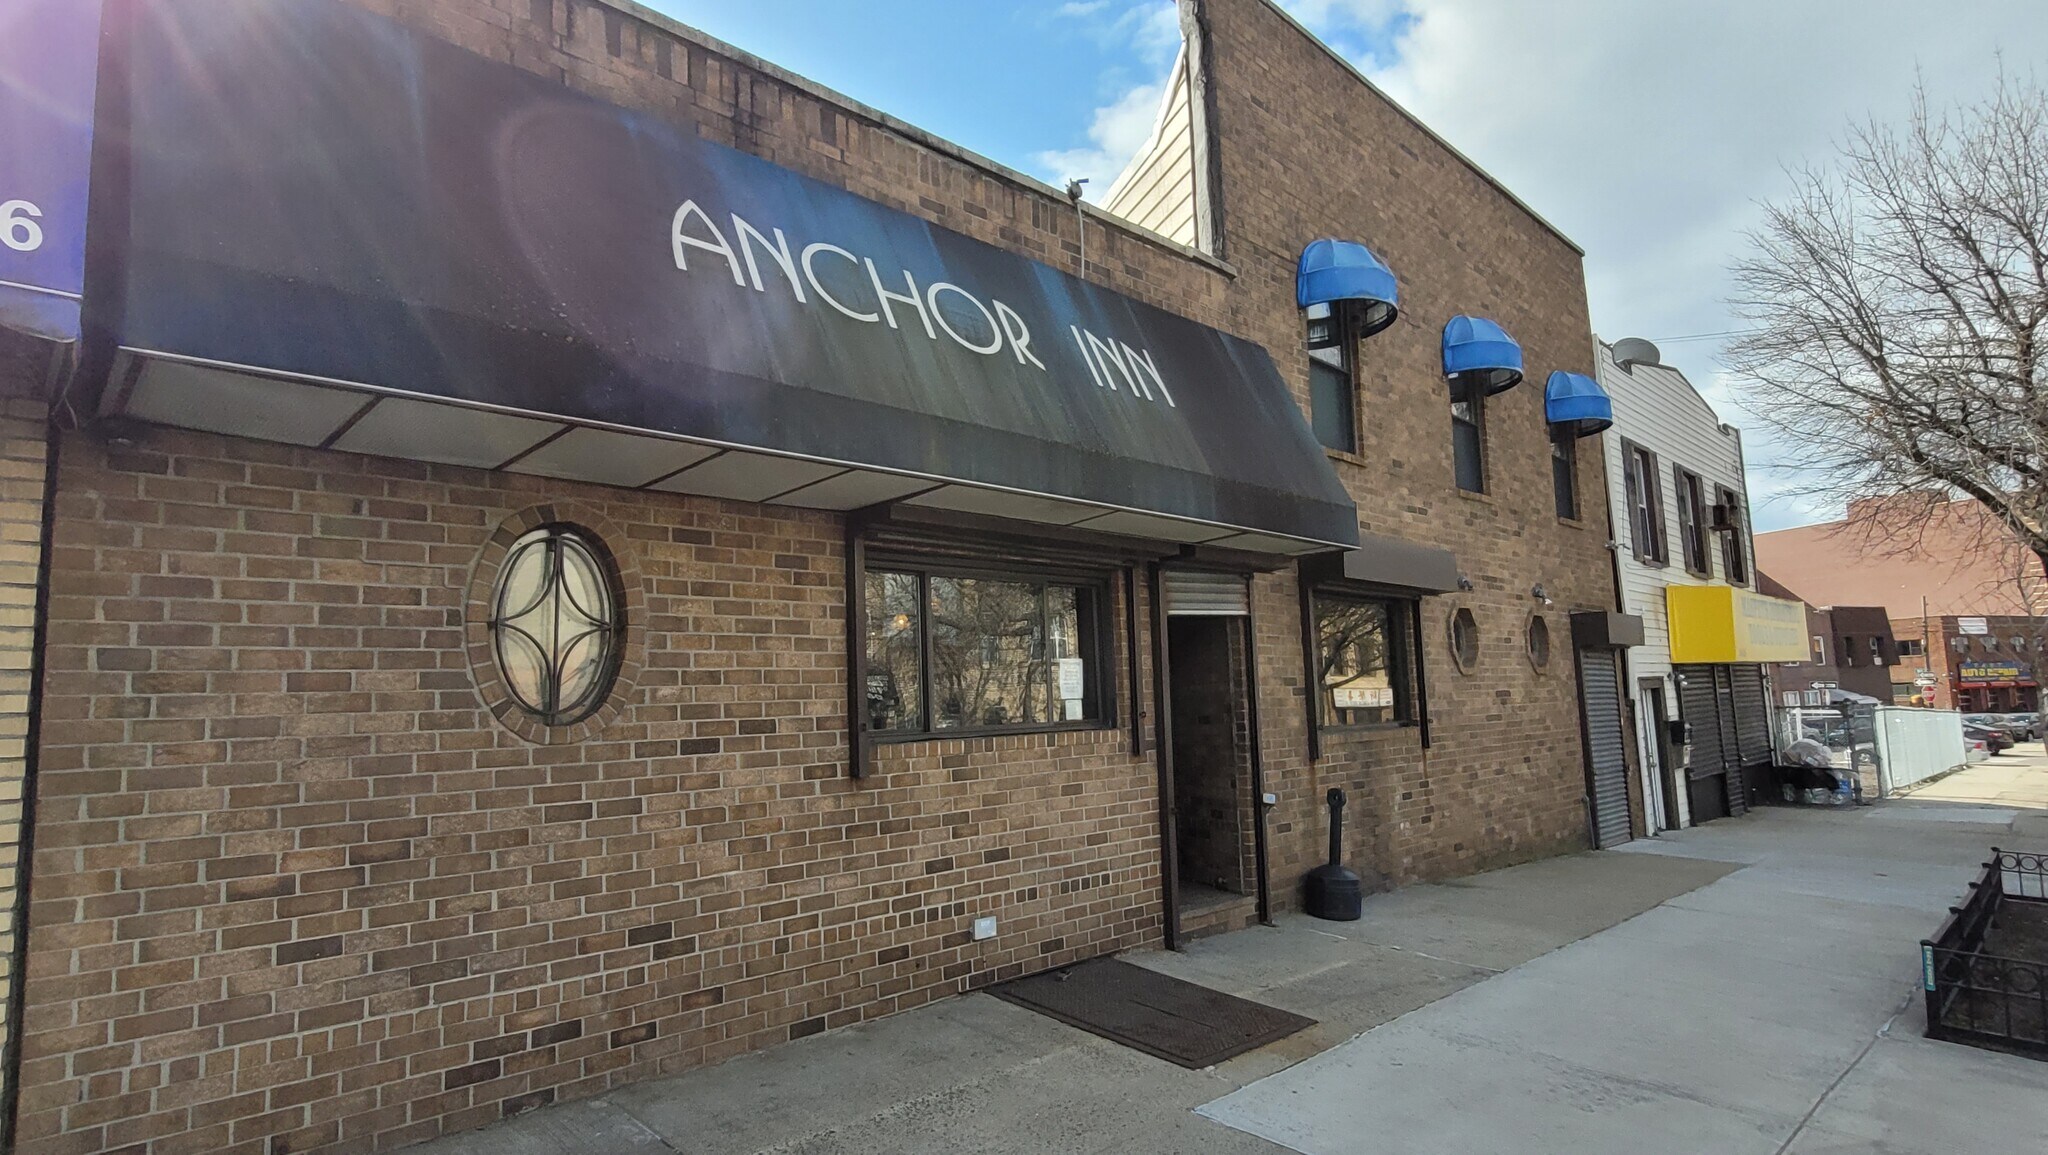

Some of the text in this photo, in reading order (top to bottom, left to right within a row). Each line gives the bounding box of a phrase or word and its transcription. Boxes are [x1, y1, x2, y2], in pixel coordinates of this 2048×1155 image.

[0, 199, 43, 252] 6
[670, 198, 1176, 408] ANCHOR INN
